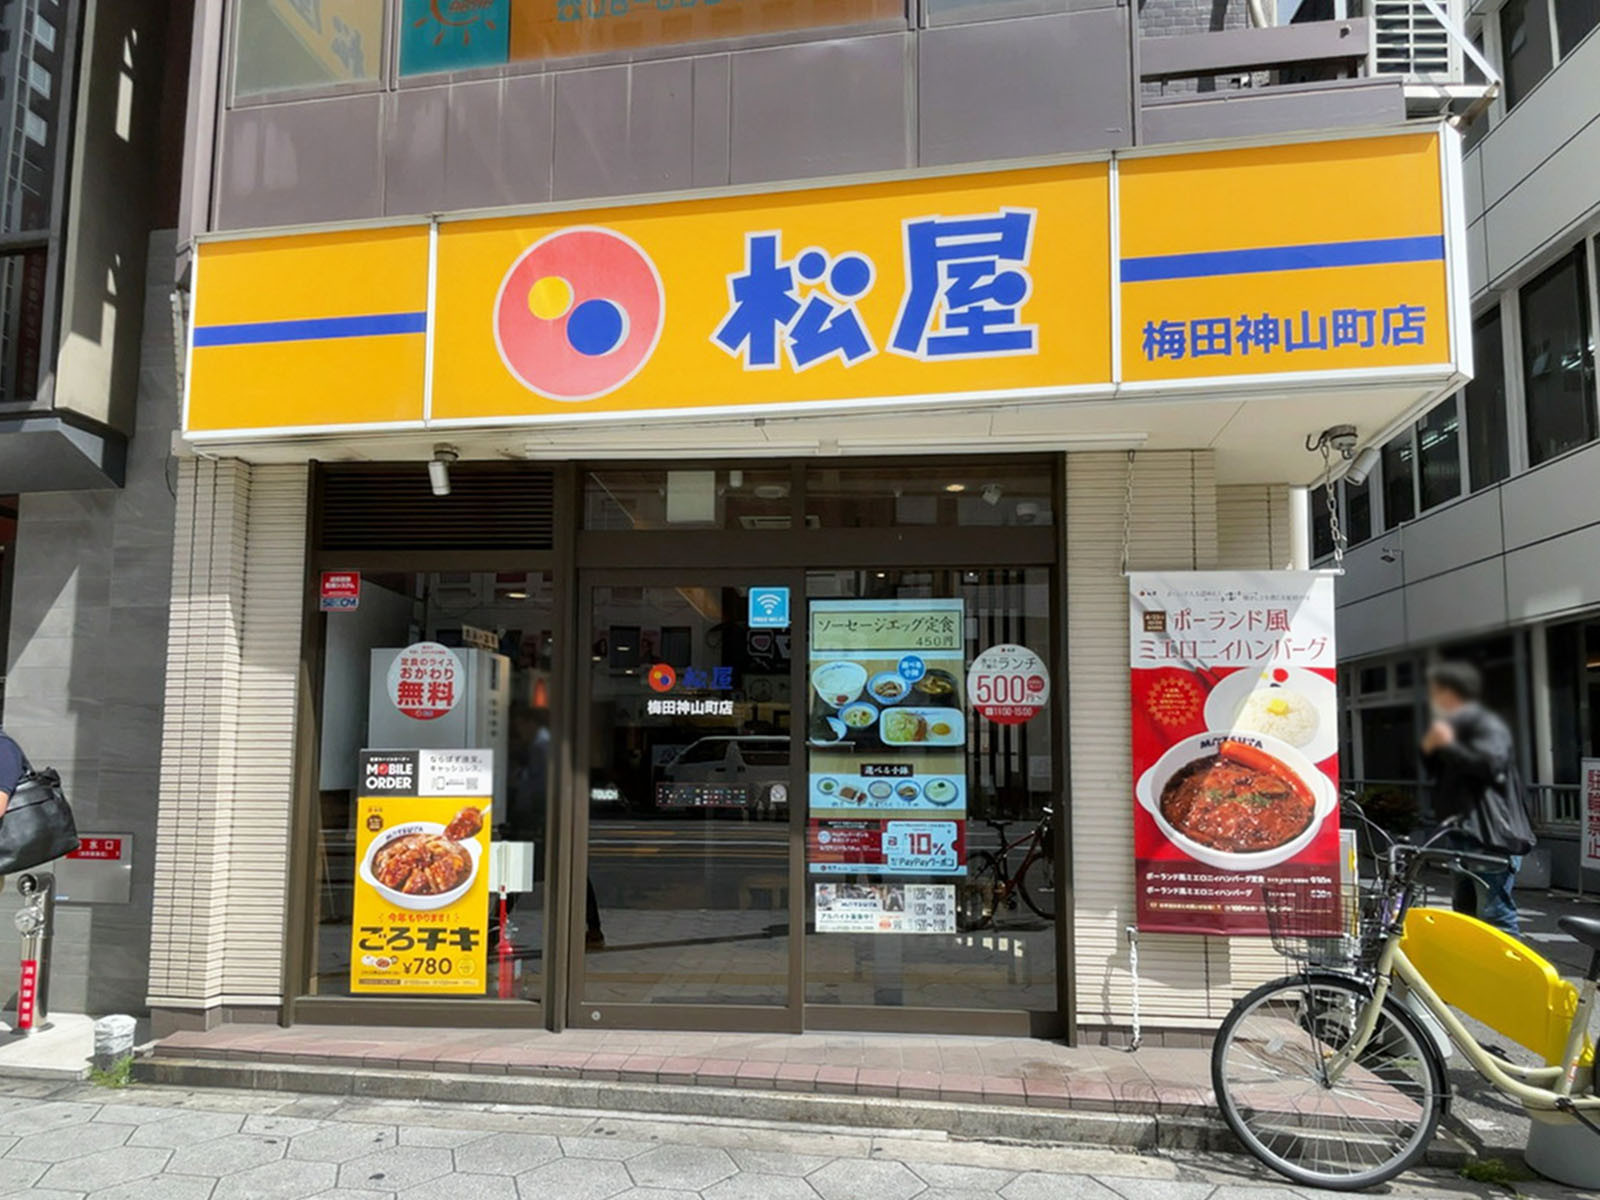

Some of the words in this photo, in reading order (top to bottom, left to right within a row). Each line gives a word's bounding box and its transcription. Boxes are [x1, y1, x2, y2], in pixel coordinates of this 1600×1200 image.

[709, 206, 1039, 374] 松屋
[1141, 304, 1427, 362] 梅田神山町店
[818, 615, 954, 633] ソーセージエッグ定食
[1174, 608, 1290, 632] ポーランド風
[915, 636, 954, 647] 450円
[1139, 637, 1327, 661] ミエロニィハンバーグ
[999, 656, 1037, 670] ランチ
[400, 667, 454, 680] おかわり
[682, 666, 733, 690] 松屋
[397, 681, 455, 707] 無料
[647, 700, 734, 715] 梅田神山町店
[366, 763, 412, 775] MOBILE
[366, 777, 412, 789] ORDER
[358, 926, 480, 952] ごろチキ
[402, 957, 452, 975] ¥780
